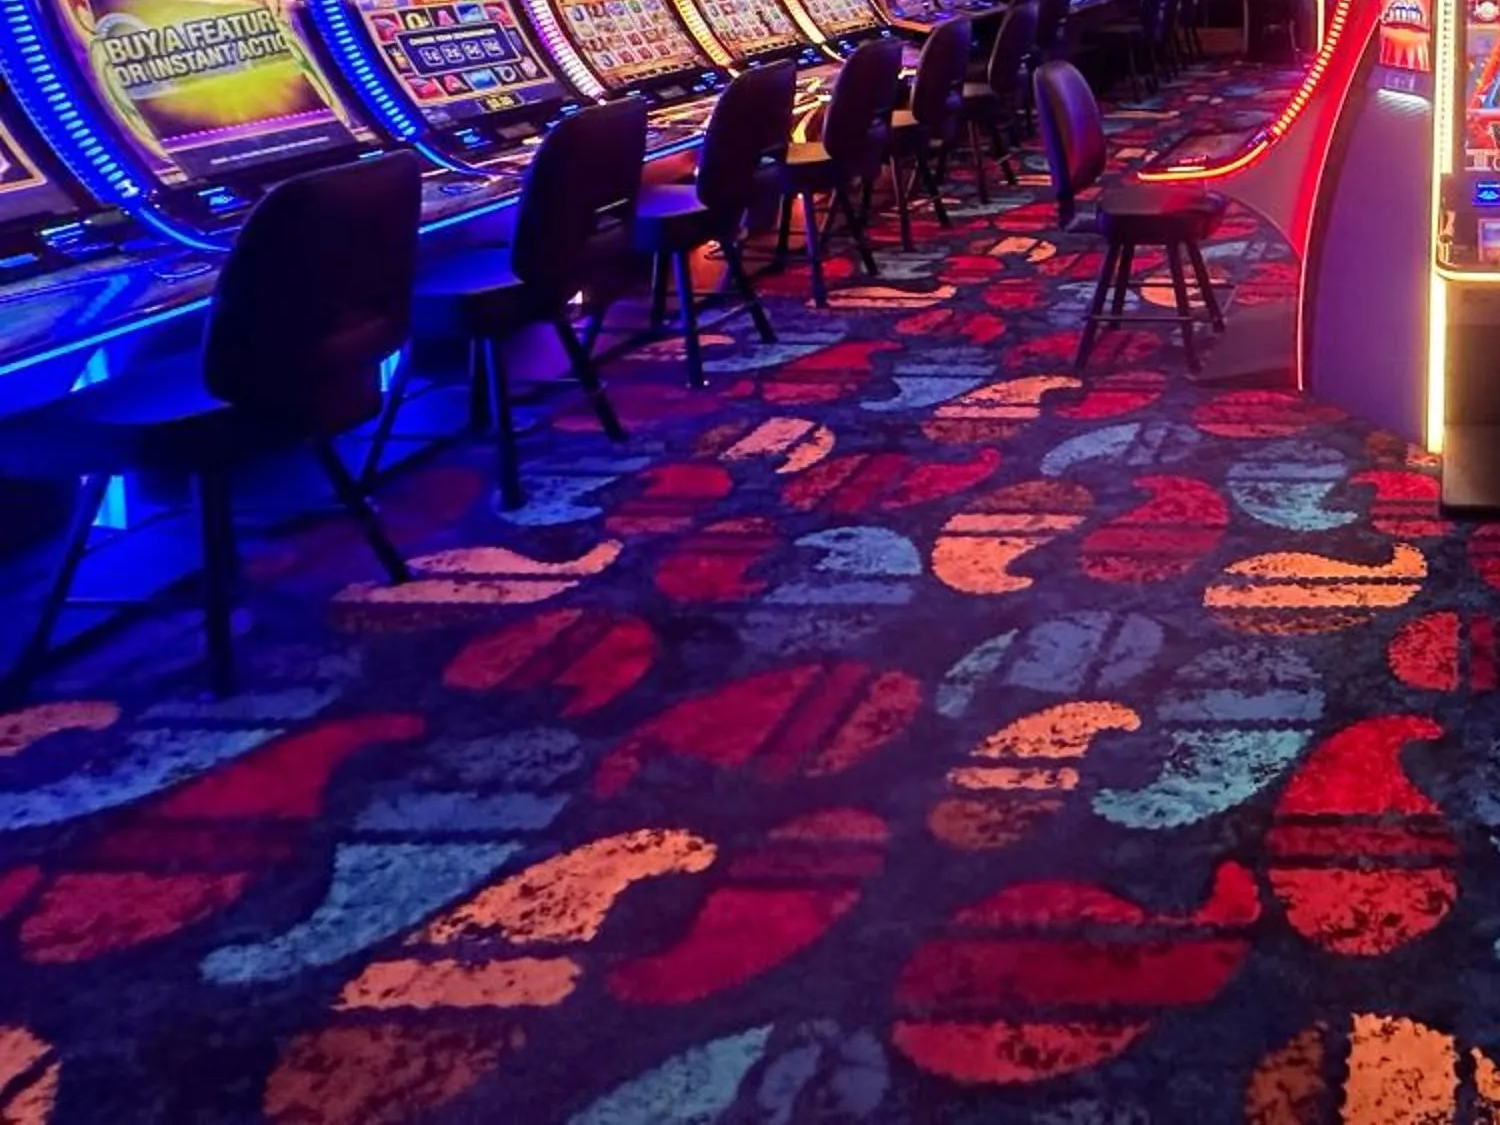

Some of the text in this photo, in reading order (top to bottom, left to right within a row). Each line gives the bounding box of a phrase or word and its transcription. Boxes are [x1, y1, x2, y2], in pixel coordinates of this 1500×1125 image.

[106, 33, 159, 65] BUY
[166, 27, 185, 51] A
[149, 43, 235, 77] INSTANT
